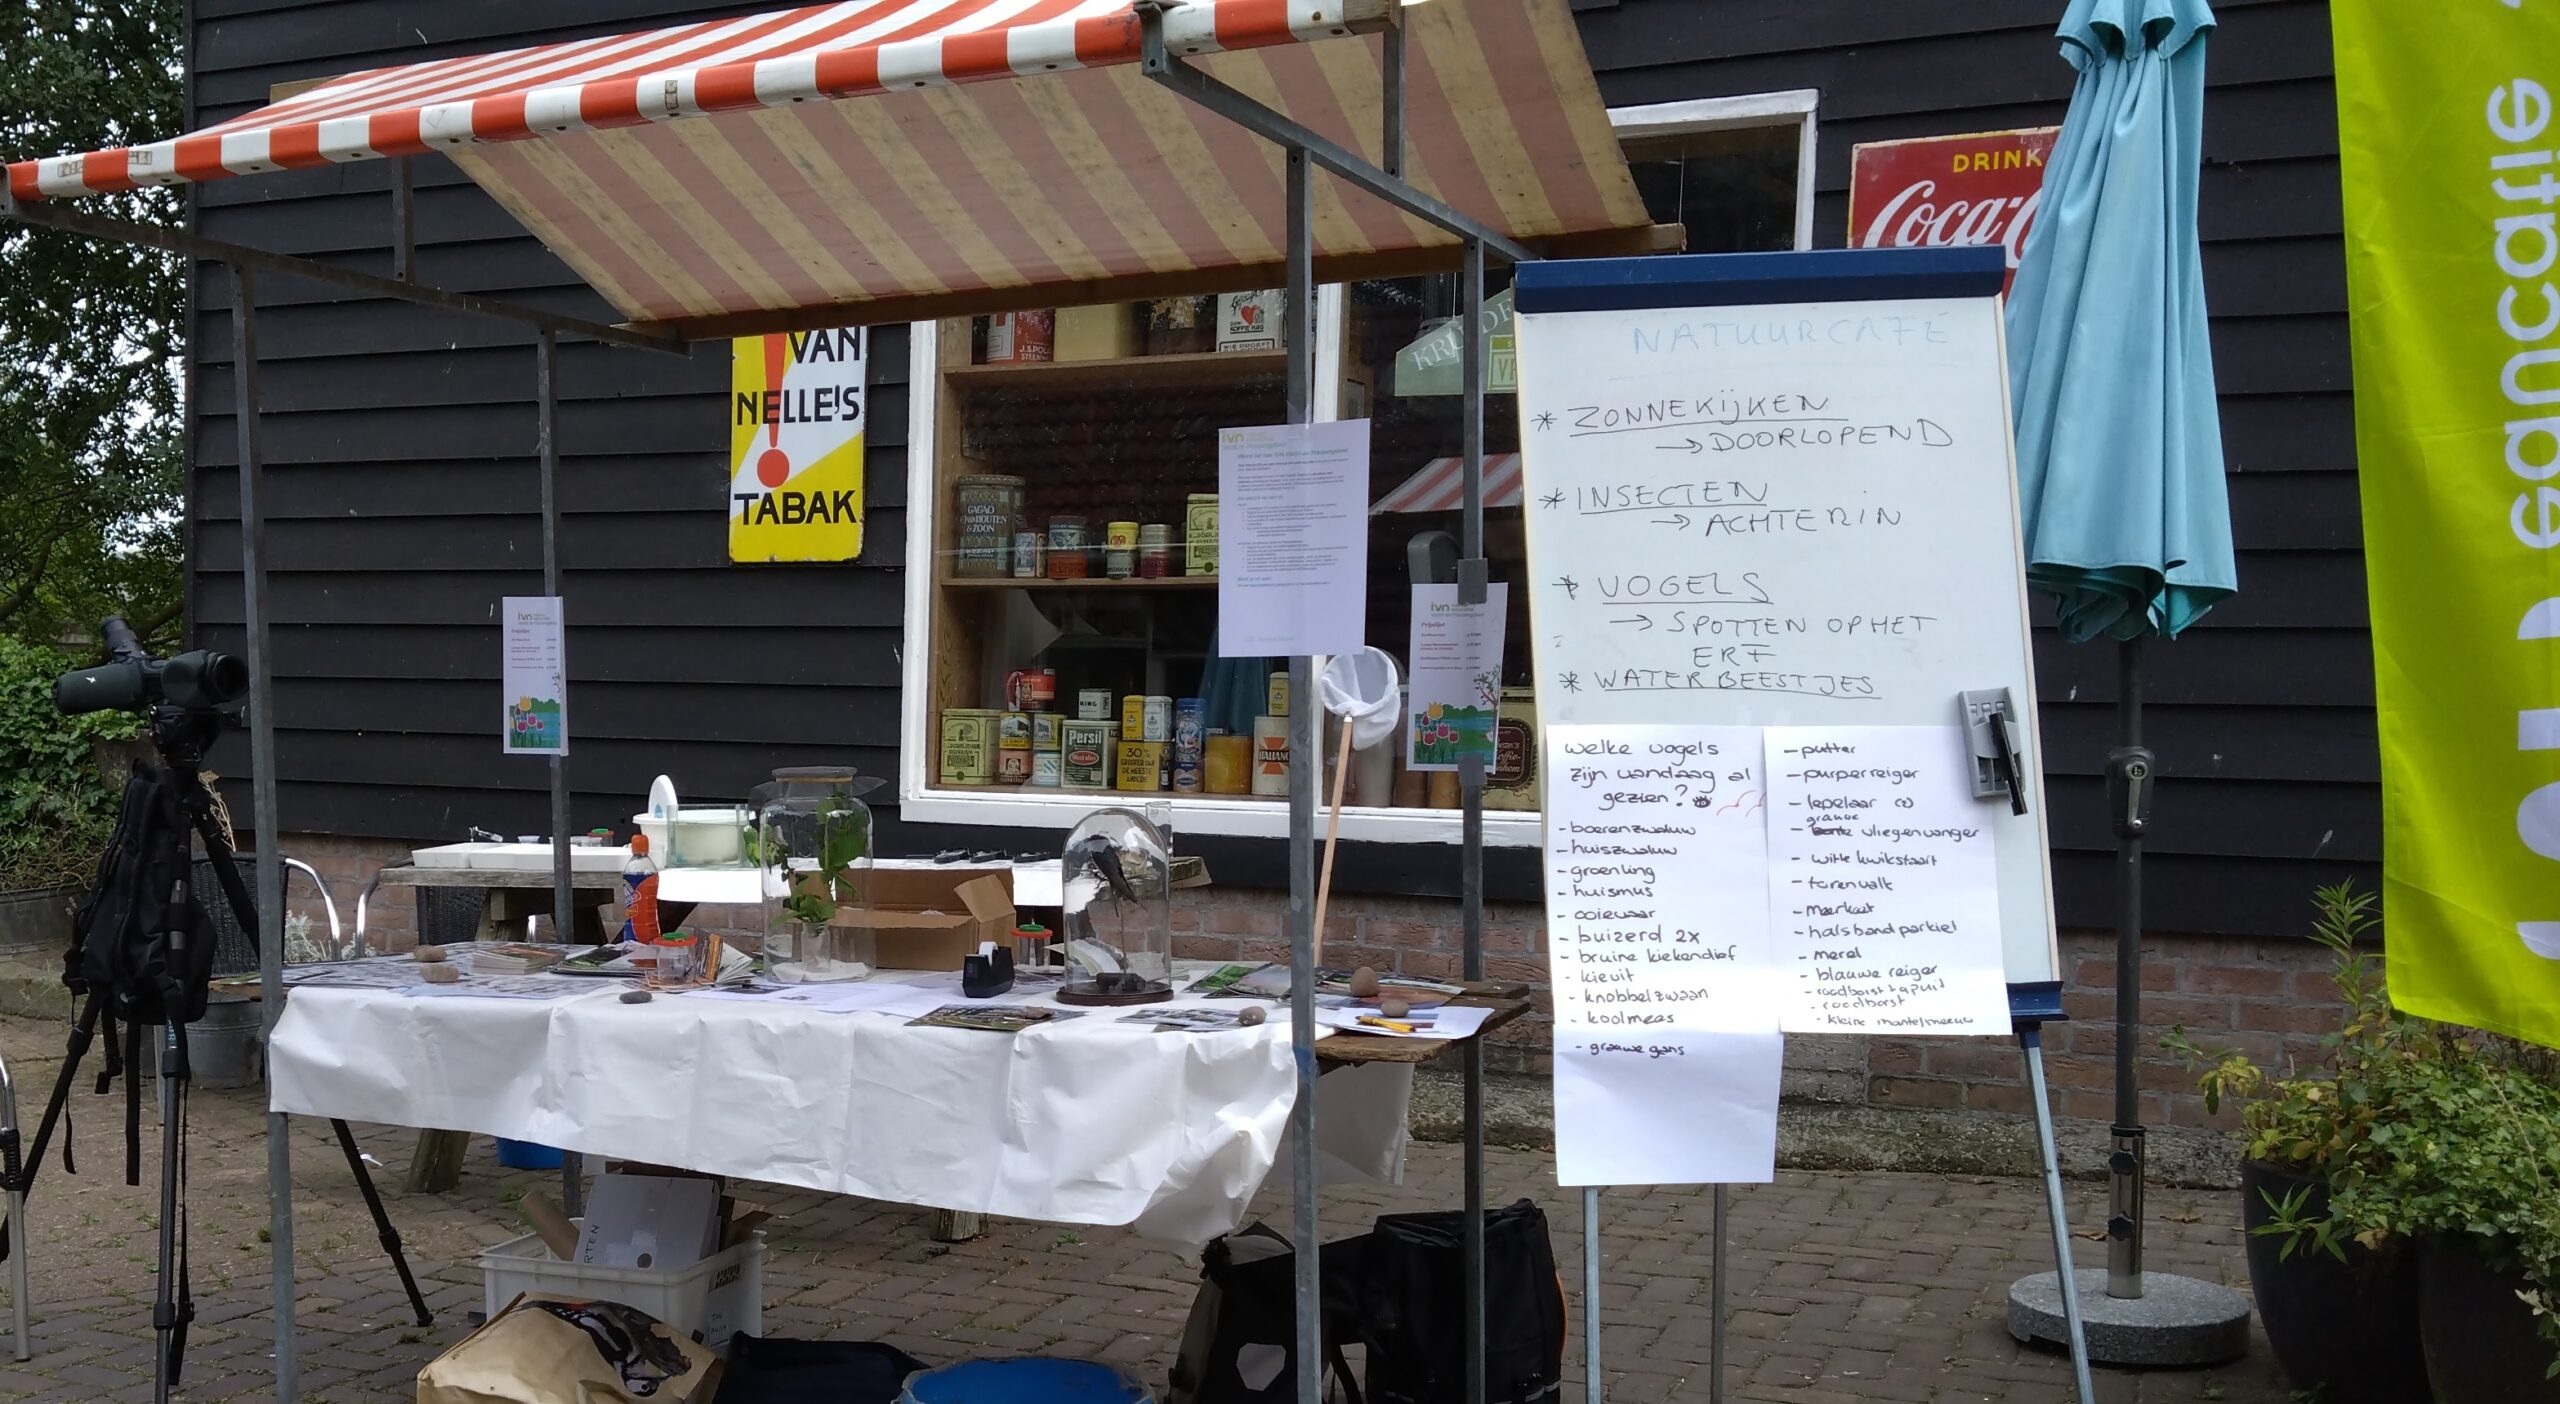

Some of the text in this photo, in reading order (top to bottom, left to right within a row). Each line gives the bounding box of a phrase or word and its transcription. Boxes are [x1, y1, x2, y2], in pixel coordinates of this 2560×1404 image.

[1953, 148, 2043, 173] DRINK
[787, 327, 861, 364] VAN
[736, 384, 860, 426] NELLE'S
[1710, 419, 1953, 453] DOORLOPEND
[1578, 480, 1768, 509] INSECTEN
[734, 490, 857, 525] TABAK
[1706, 504, 1902, 537] ACHTERIN
[1598, 572, 1773, 604] VOGELS
[518, 612, 531, 621] ivn
[1431, 602, 1450, 612] ivn
[1667, 613, 1938, 635] SPOTTEN OP HET
[1693, 644, 1777, 668] ERF
[1068, 730, 1102, 745] Persil
[1564, 739, 1720, 766] welke vogels
[1801, 743, 1856, 759] putter
[1570, 765, 1751, 793] zijn vandaag al
[1803, 767, 1919, 785] purperreiger
[1807, 794, 1877, 810] lepelaar
[1570, 820, 1697, 836] boerenzwaluw
[1861, 822, 1981, 843] vliegenvanger
[1571, 838, 1678, 856] huiszwaluw
[1811, 850, 1938, 866] witte kwikstaart
[1570, 864, 1656, 884] groenling
[1573, 883, 1654, 898] huismus
[1574, 907, 1656, 921] ooievaar
[1578, 924, 1663, 944] buizerd
[1579, 945, 1738, 965] bruine kiekendief
[1814, 947, 1862, 961] merel
[1580, 969, 1635, 984] kievit
[1816, 965, 1938, 982] blauwe reiger
[1827, 1014, 1866, 1027] kleine
[1648, 1044, 1686, 1059] gans
